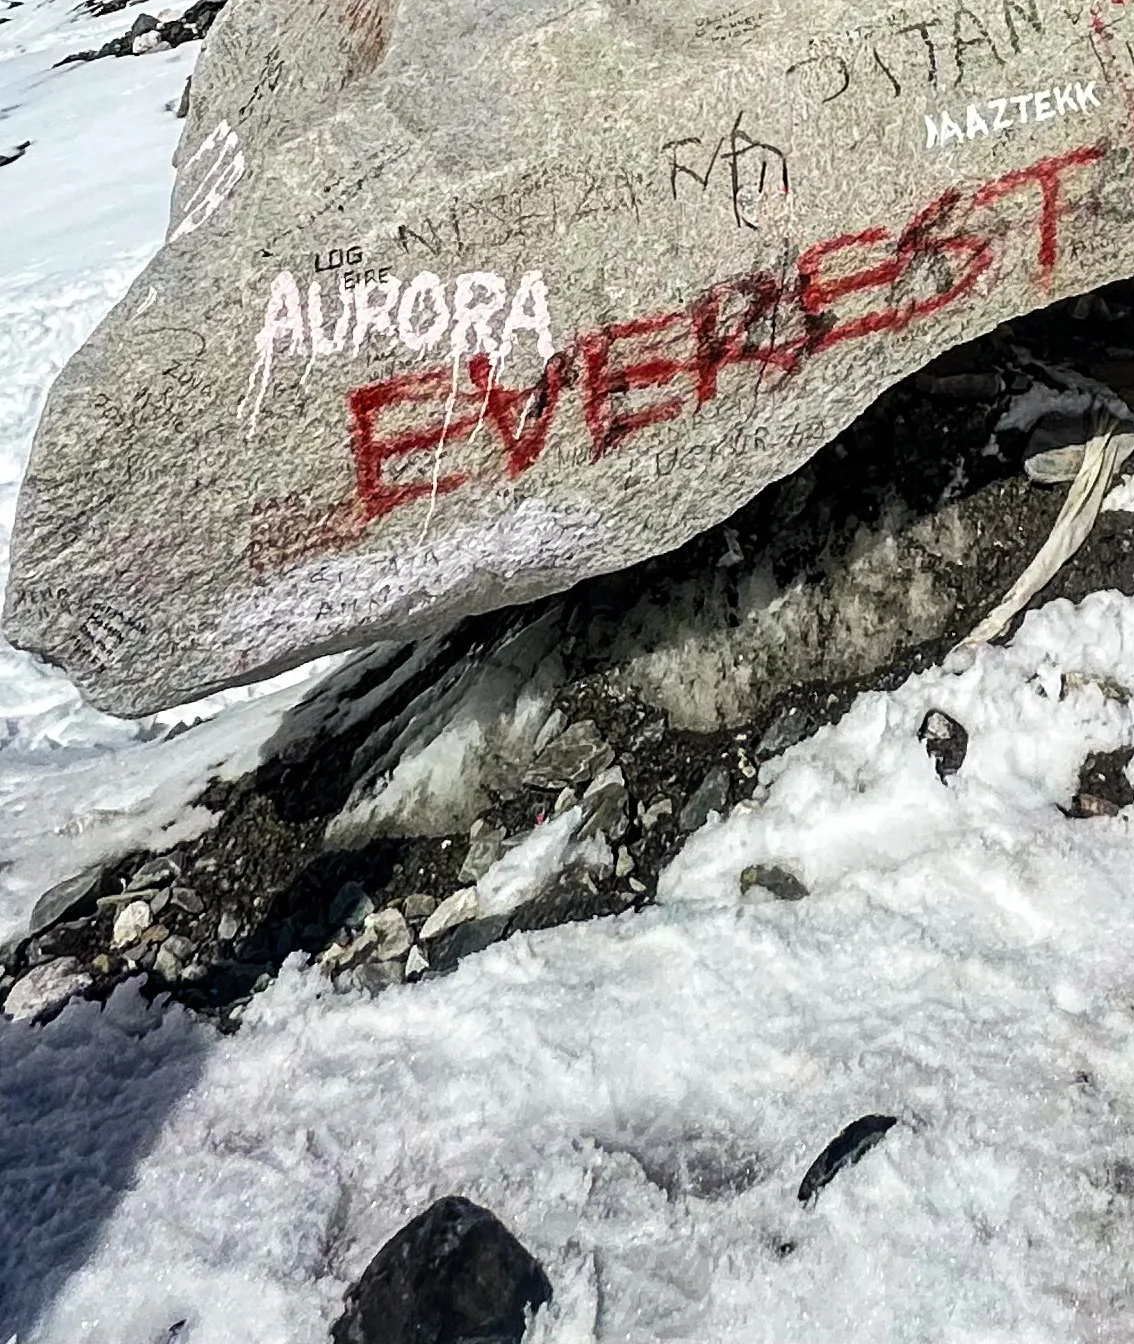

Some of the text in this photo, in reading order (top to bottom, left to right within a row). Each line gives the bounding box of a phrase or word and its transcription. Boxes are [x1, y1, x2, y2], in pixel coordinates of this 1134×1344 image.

[314, 246, 364, 272] LOG
[254, 269, 555, 361] AURORA
[347, 143, 1107, 524] EVEREST
